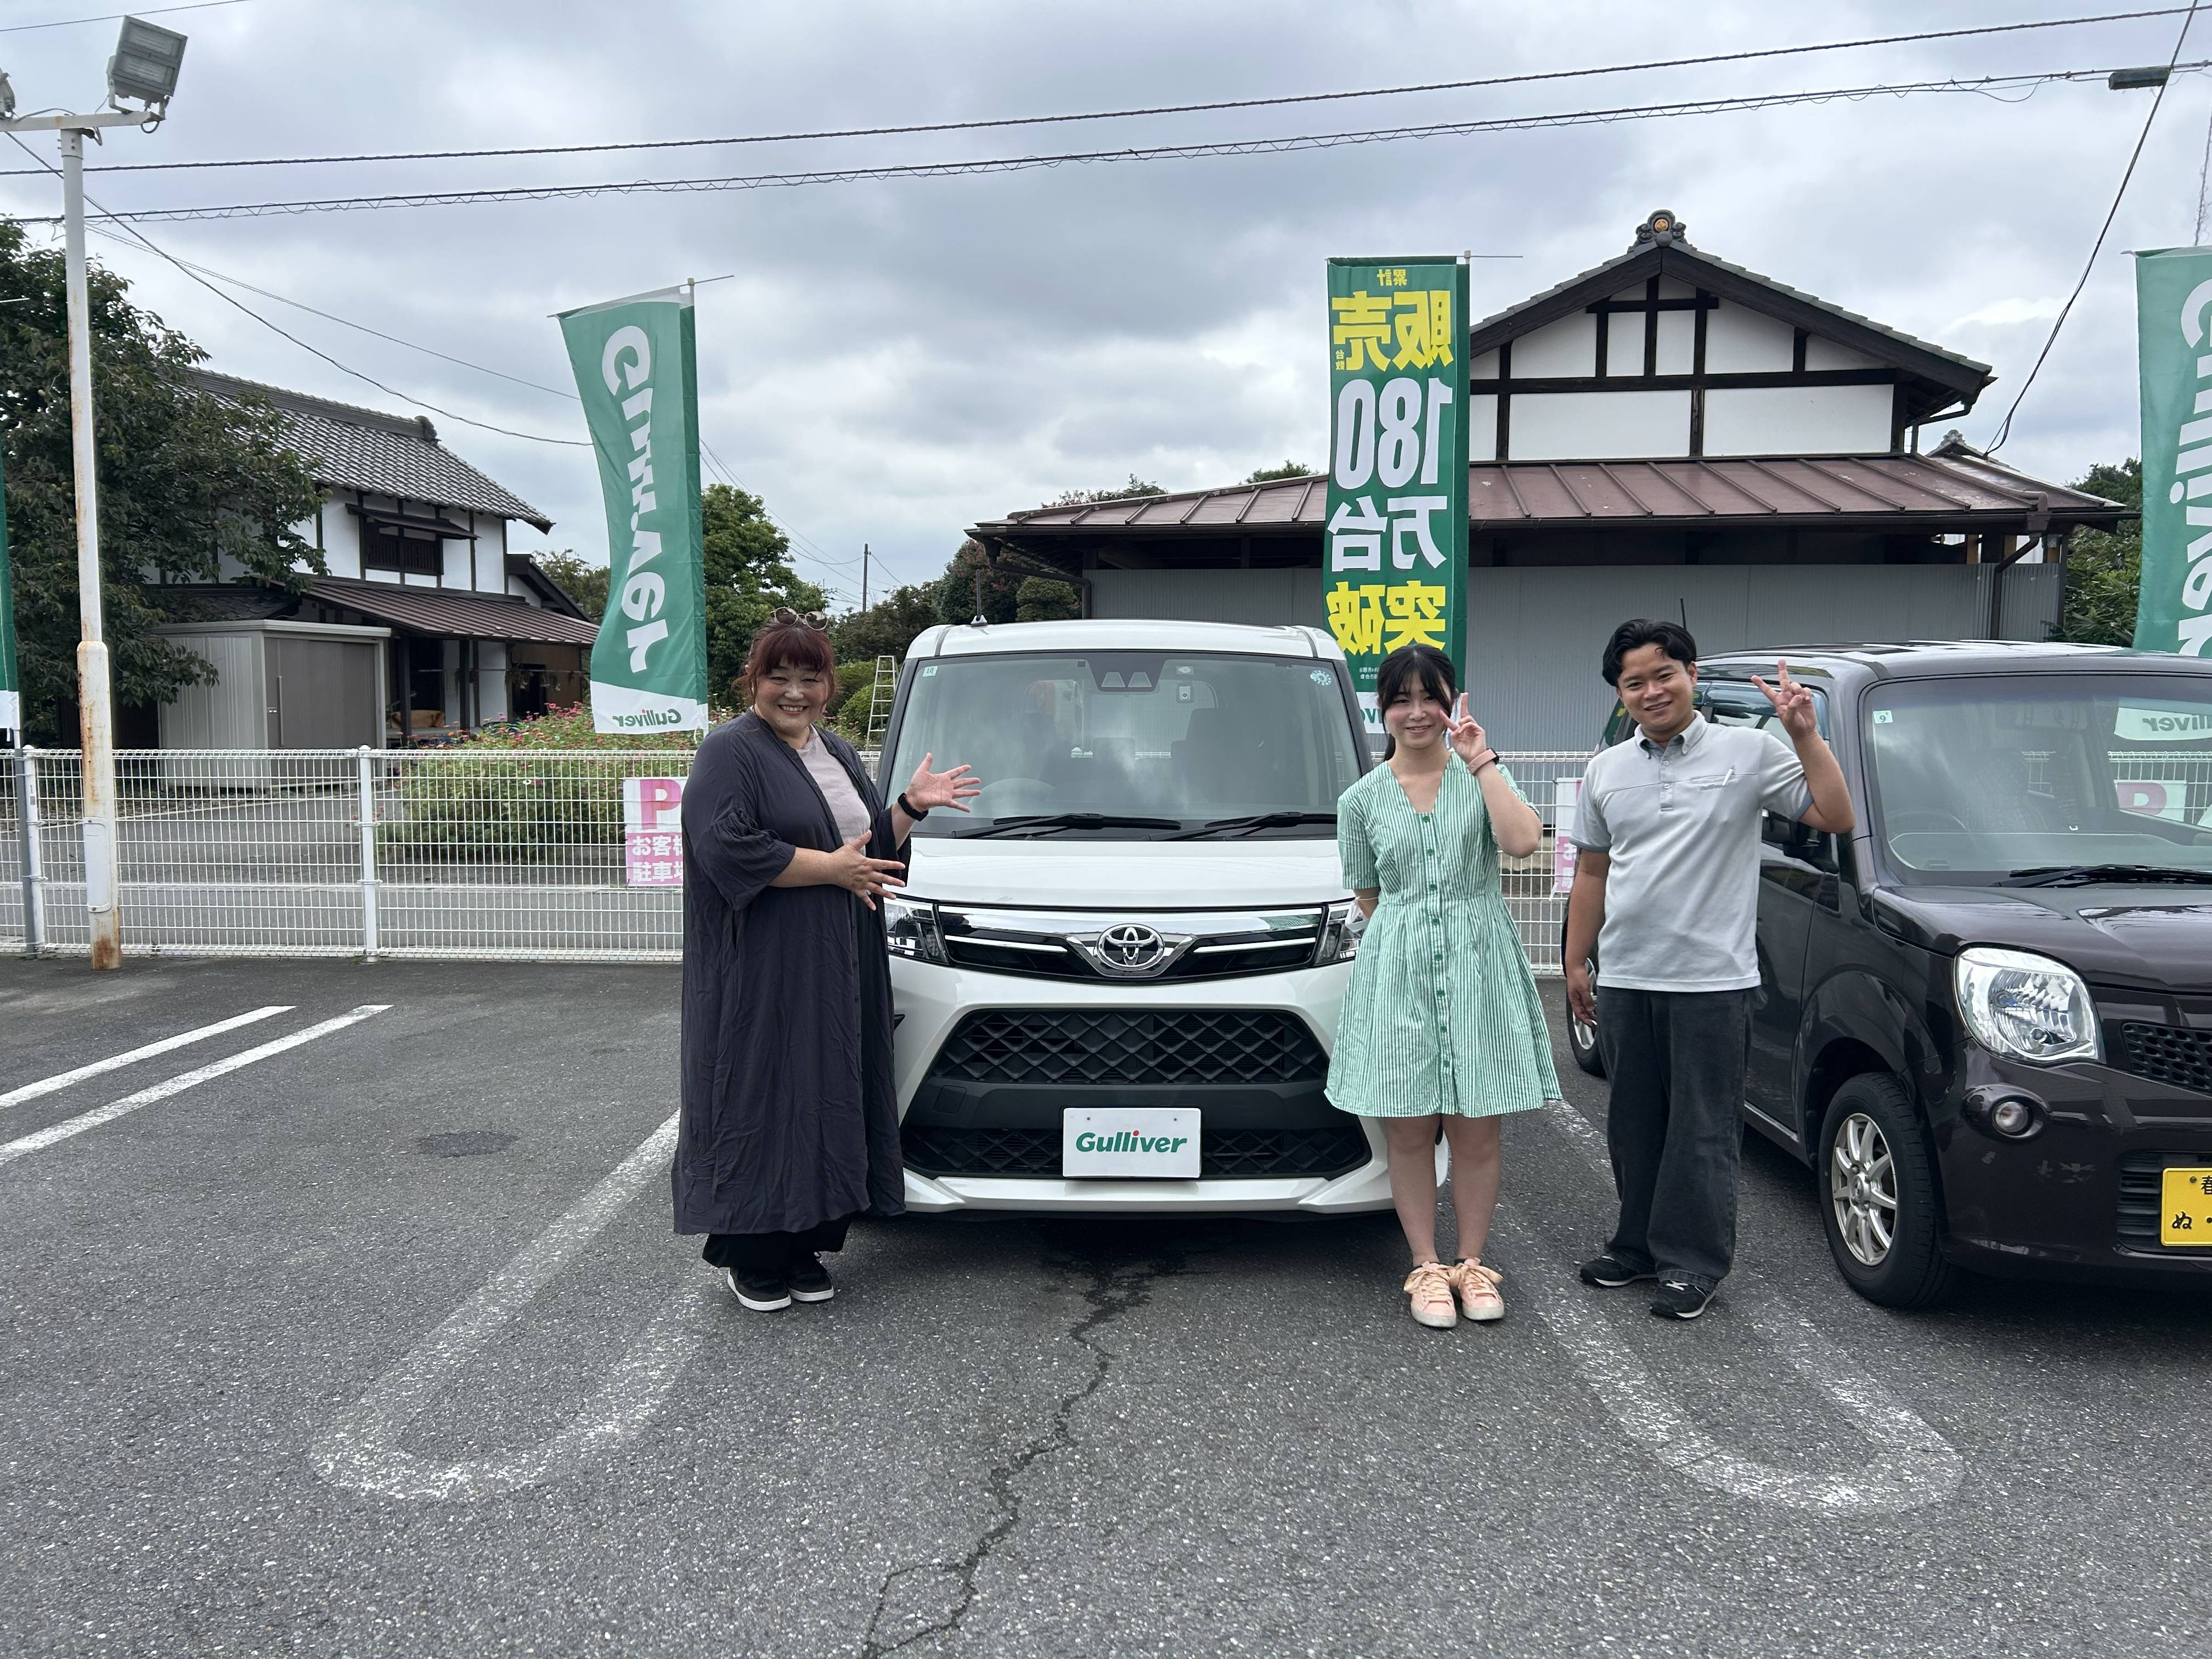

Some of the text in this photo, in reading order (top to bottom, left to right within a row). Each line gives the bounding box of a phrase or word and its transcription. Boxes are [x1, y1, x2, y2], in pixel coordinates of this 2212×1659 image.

[640, 778, 682, 830] P
[1075, 1130, 1187, 1153] Gulliver
[2171, 1211, 2192, 1229] ぬ
